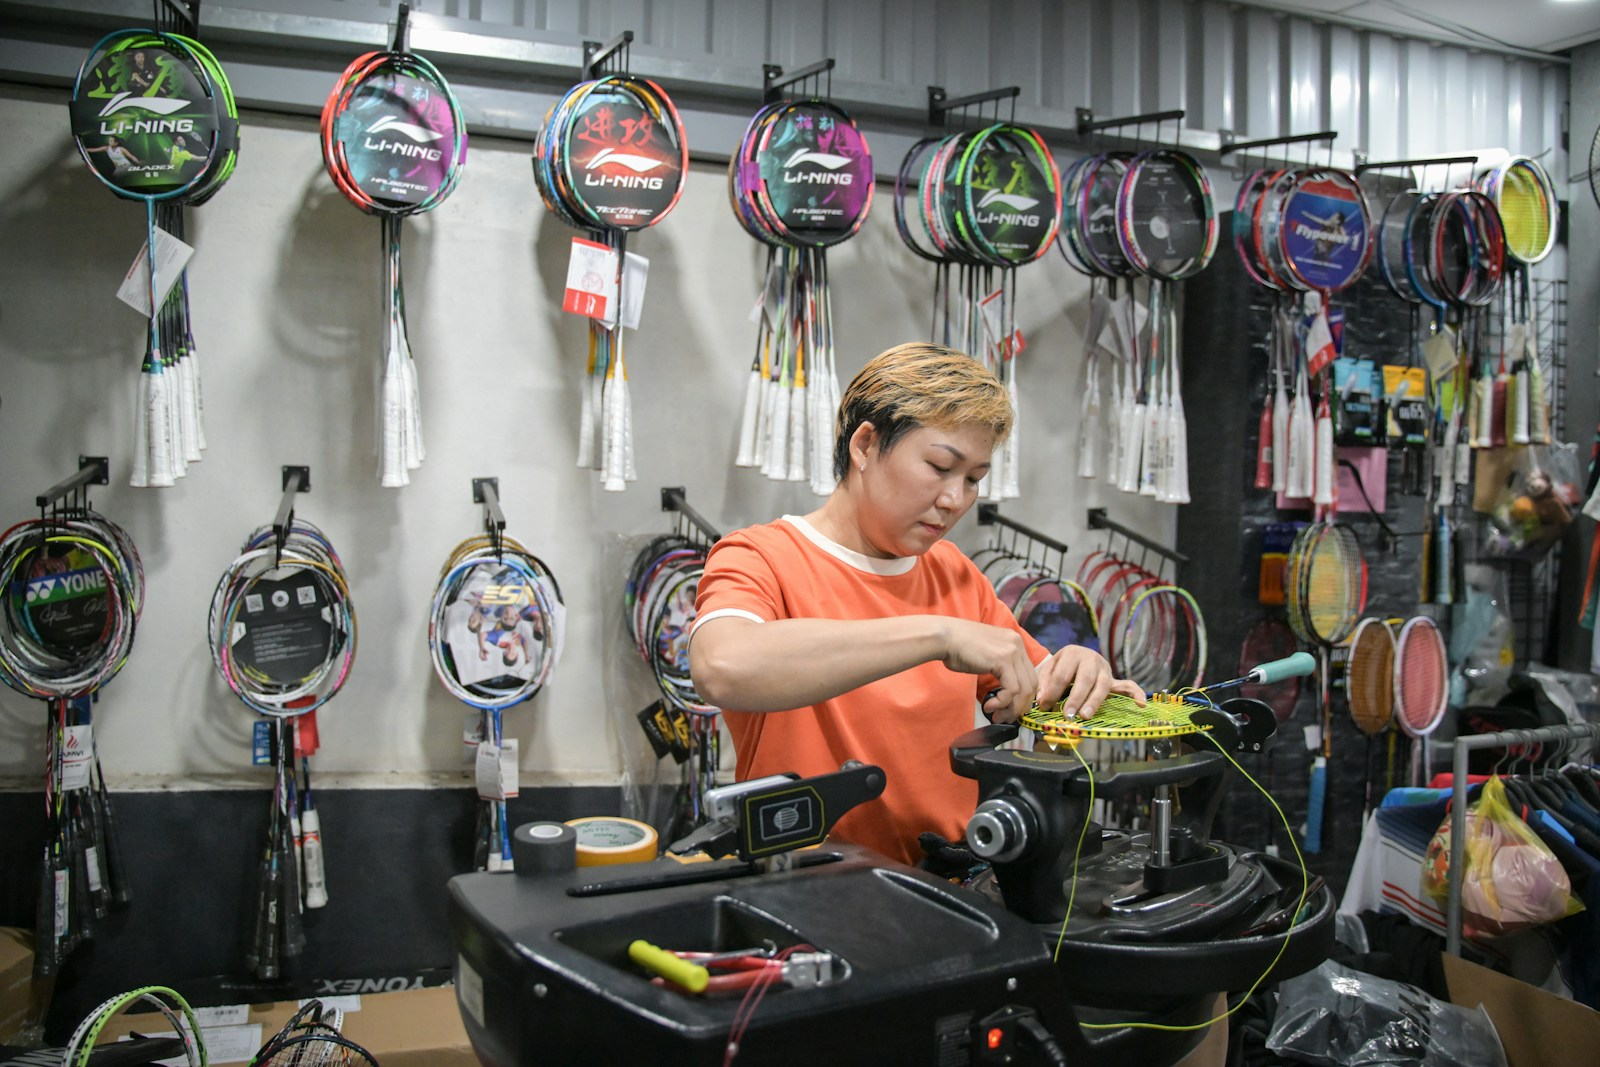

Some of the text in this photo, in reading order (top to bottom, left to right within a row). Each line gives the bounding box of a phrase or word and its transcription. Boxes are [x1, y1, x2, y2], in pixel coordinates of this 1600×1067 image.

[100, 119, 194, 135] LI-NING
[364, 137, 443, 161] LI-NING
[585, 174, 663, 190] LI-NING
[784, 171, 853, 185] LI-NING
[976, 211, 1040, 227] LI-NING
[60, 569, 107, 594] YONE
[316, 976, 424, 993] YONEX
